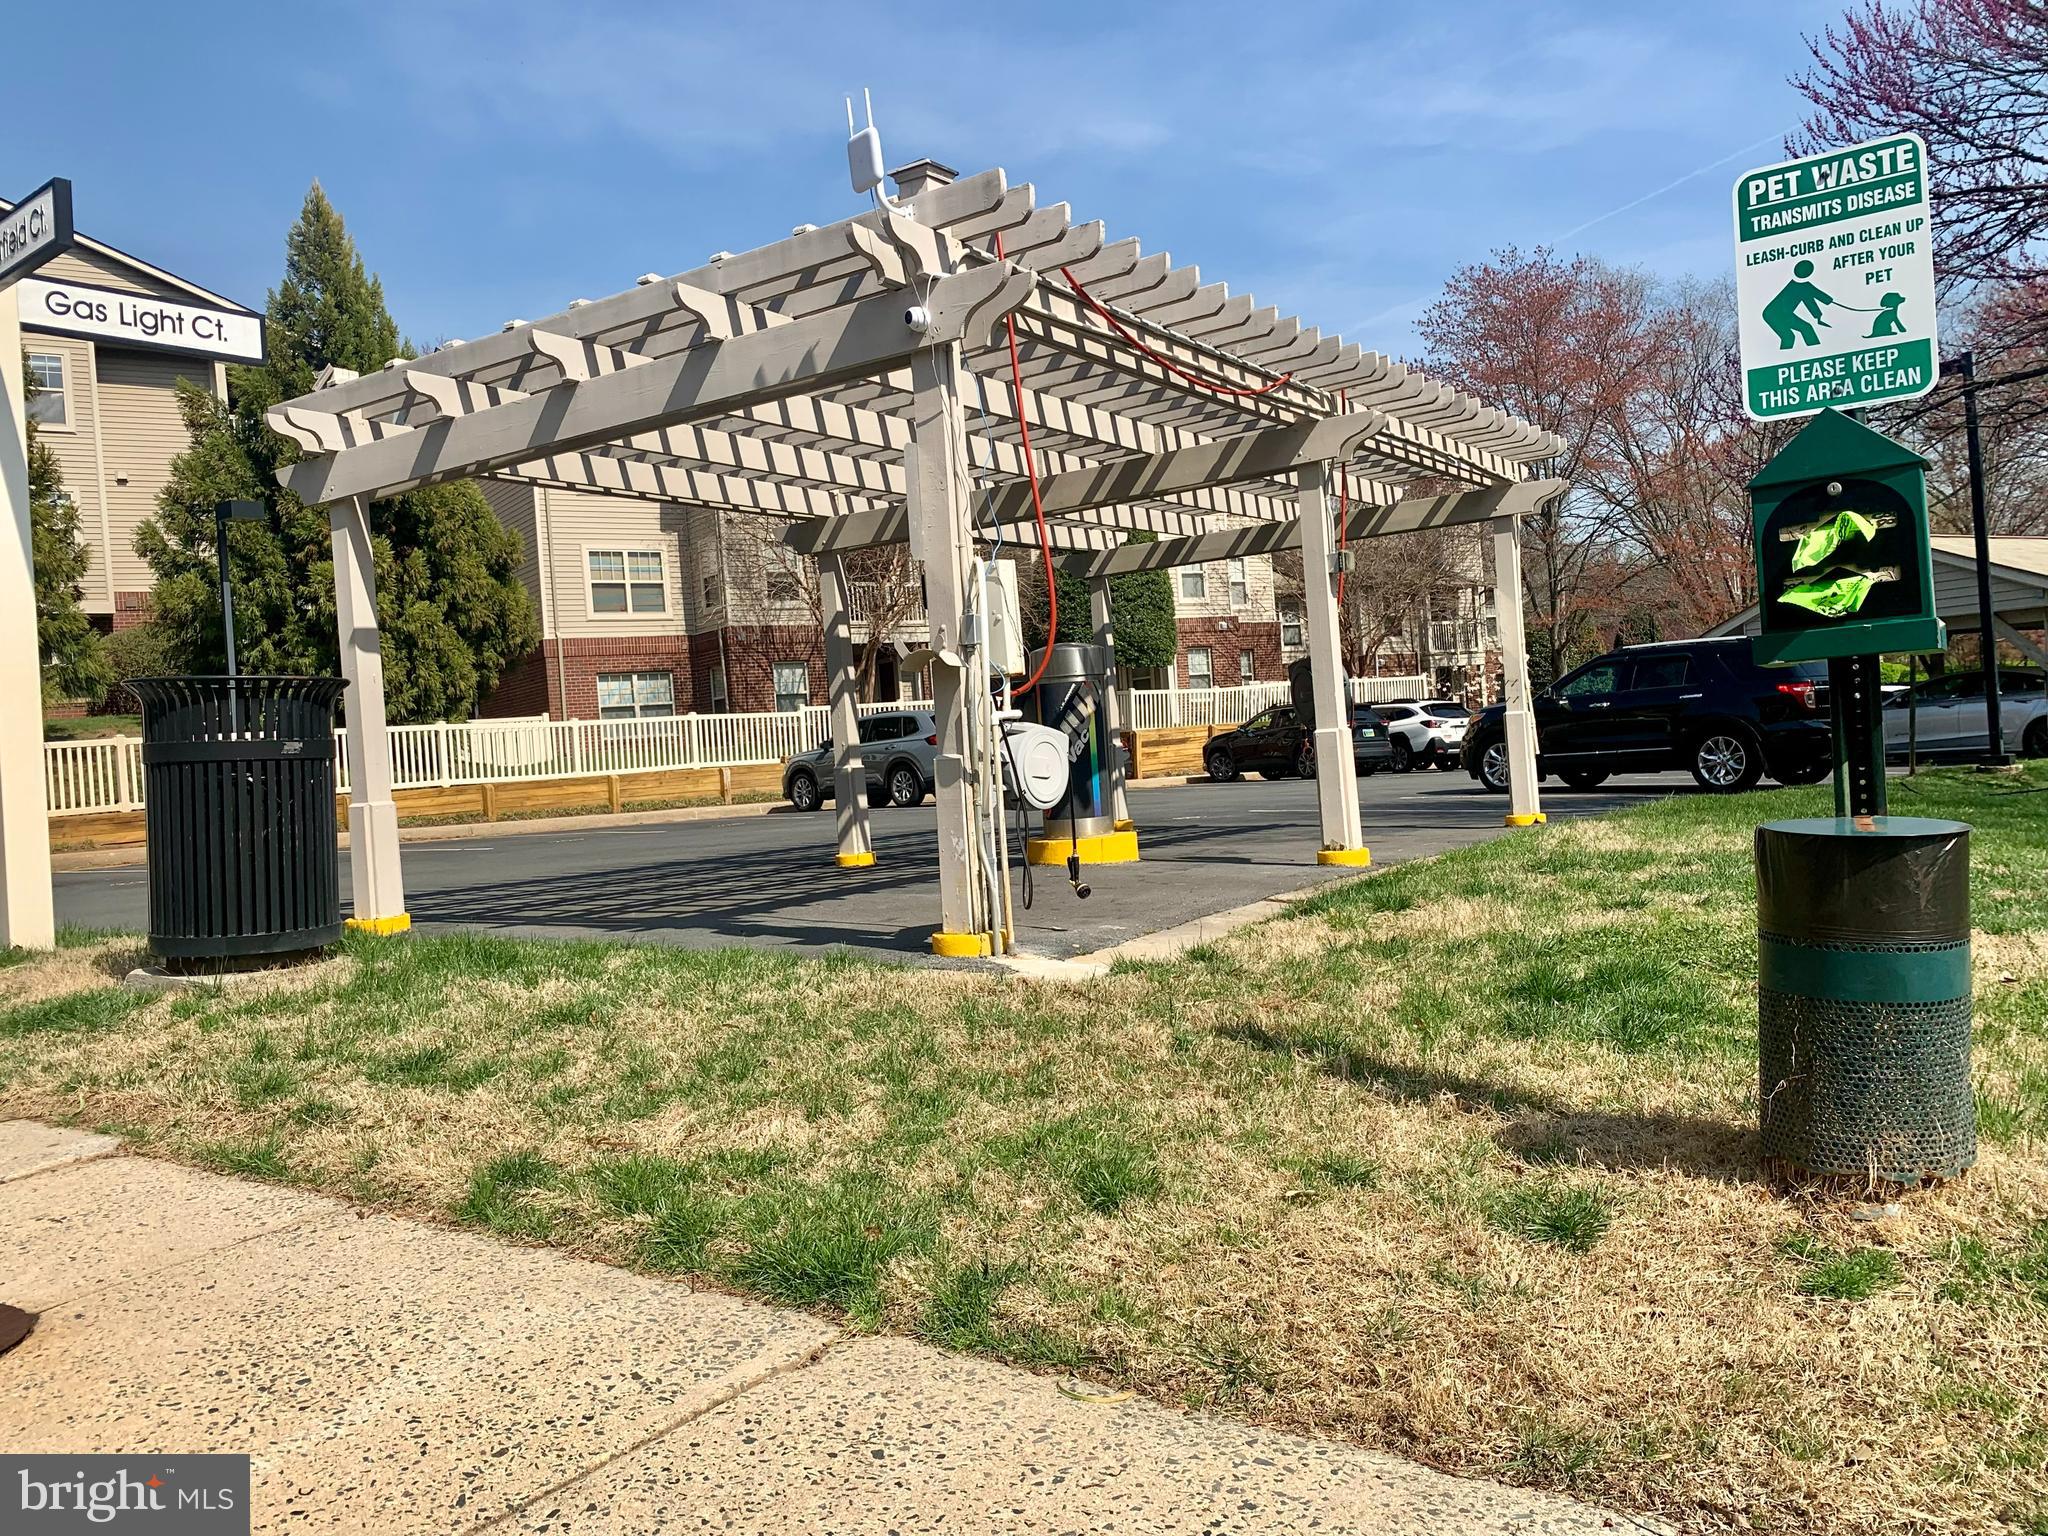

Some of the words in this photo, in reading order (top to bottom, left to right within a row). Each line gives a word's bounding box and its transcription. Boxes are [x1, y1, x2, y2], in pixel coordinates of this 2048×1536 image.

[1748, 169, 1802, 206] PET
[1811, 142, 1916, 190] WASTE
[30, 205, 47, 238] Ct.
[1751, 199, 1842, 233] TRANSMITS
[1847, 183, 1916, 211] DISEASE
[1746, 240, 1824, 267] LEASH-CURB
[1828, 232, 1855, 250] AND
[1859, 222, 1902, 244] CLEAN
[1905, 217, 1924, 232] UP
[1832, 250, 1875, 271] AFTER
[1878, 241, 1915, 262] YOUR
[1865, 267, 1893, 286] PET
[45, 290, 108, 322] Gas
[119, 301, 185, 336] Light
[191, 314, 229, 343] Ct.
[1778, 356, 1846, 386] PLEASE
[1852, 348, 1899, 373] KEEP
[1759, 387, 1800, 410] THIS
[1806, 377, 1855, 400] AREA
[1860, 366, 1921, 394] CLEAN
[1068, 728, 1090, 764] Vac
